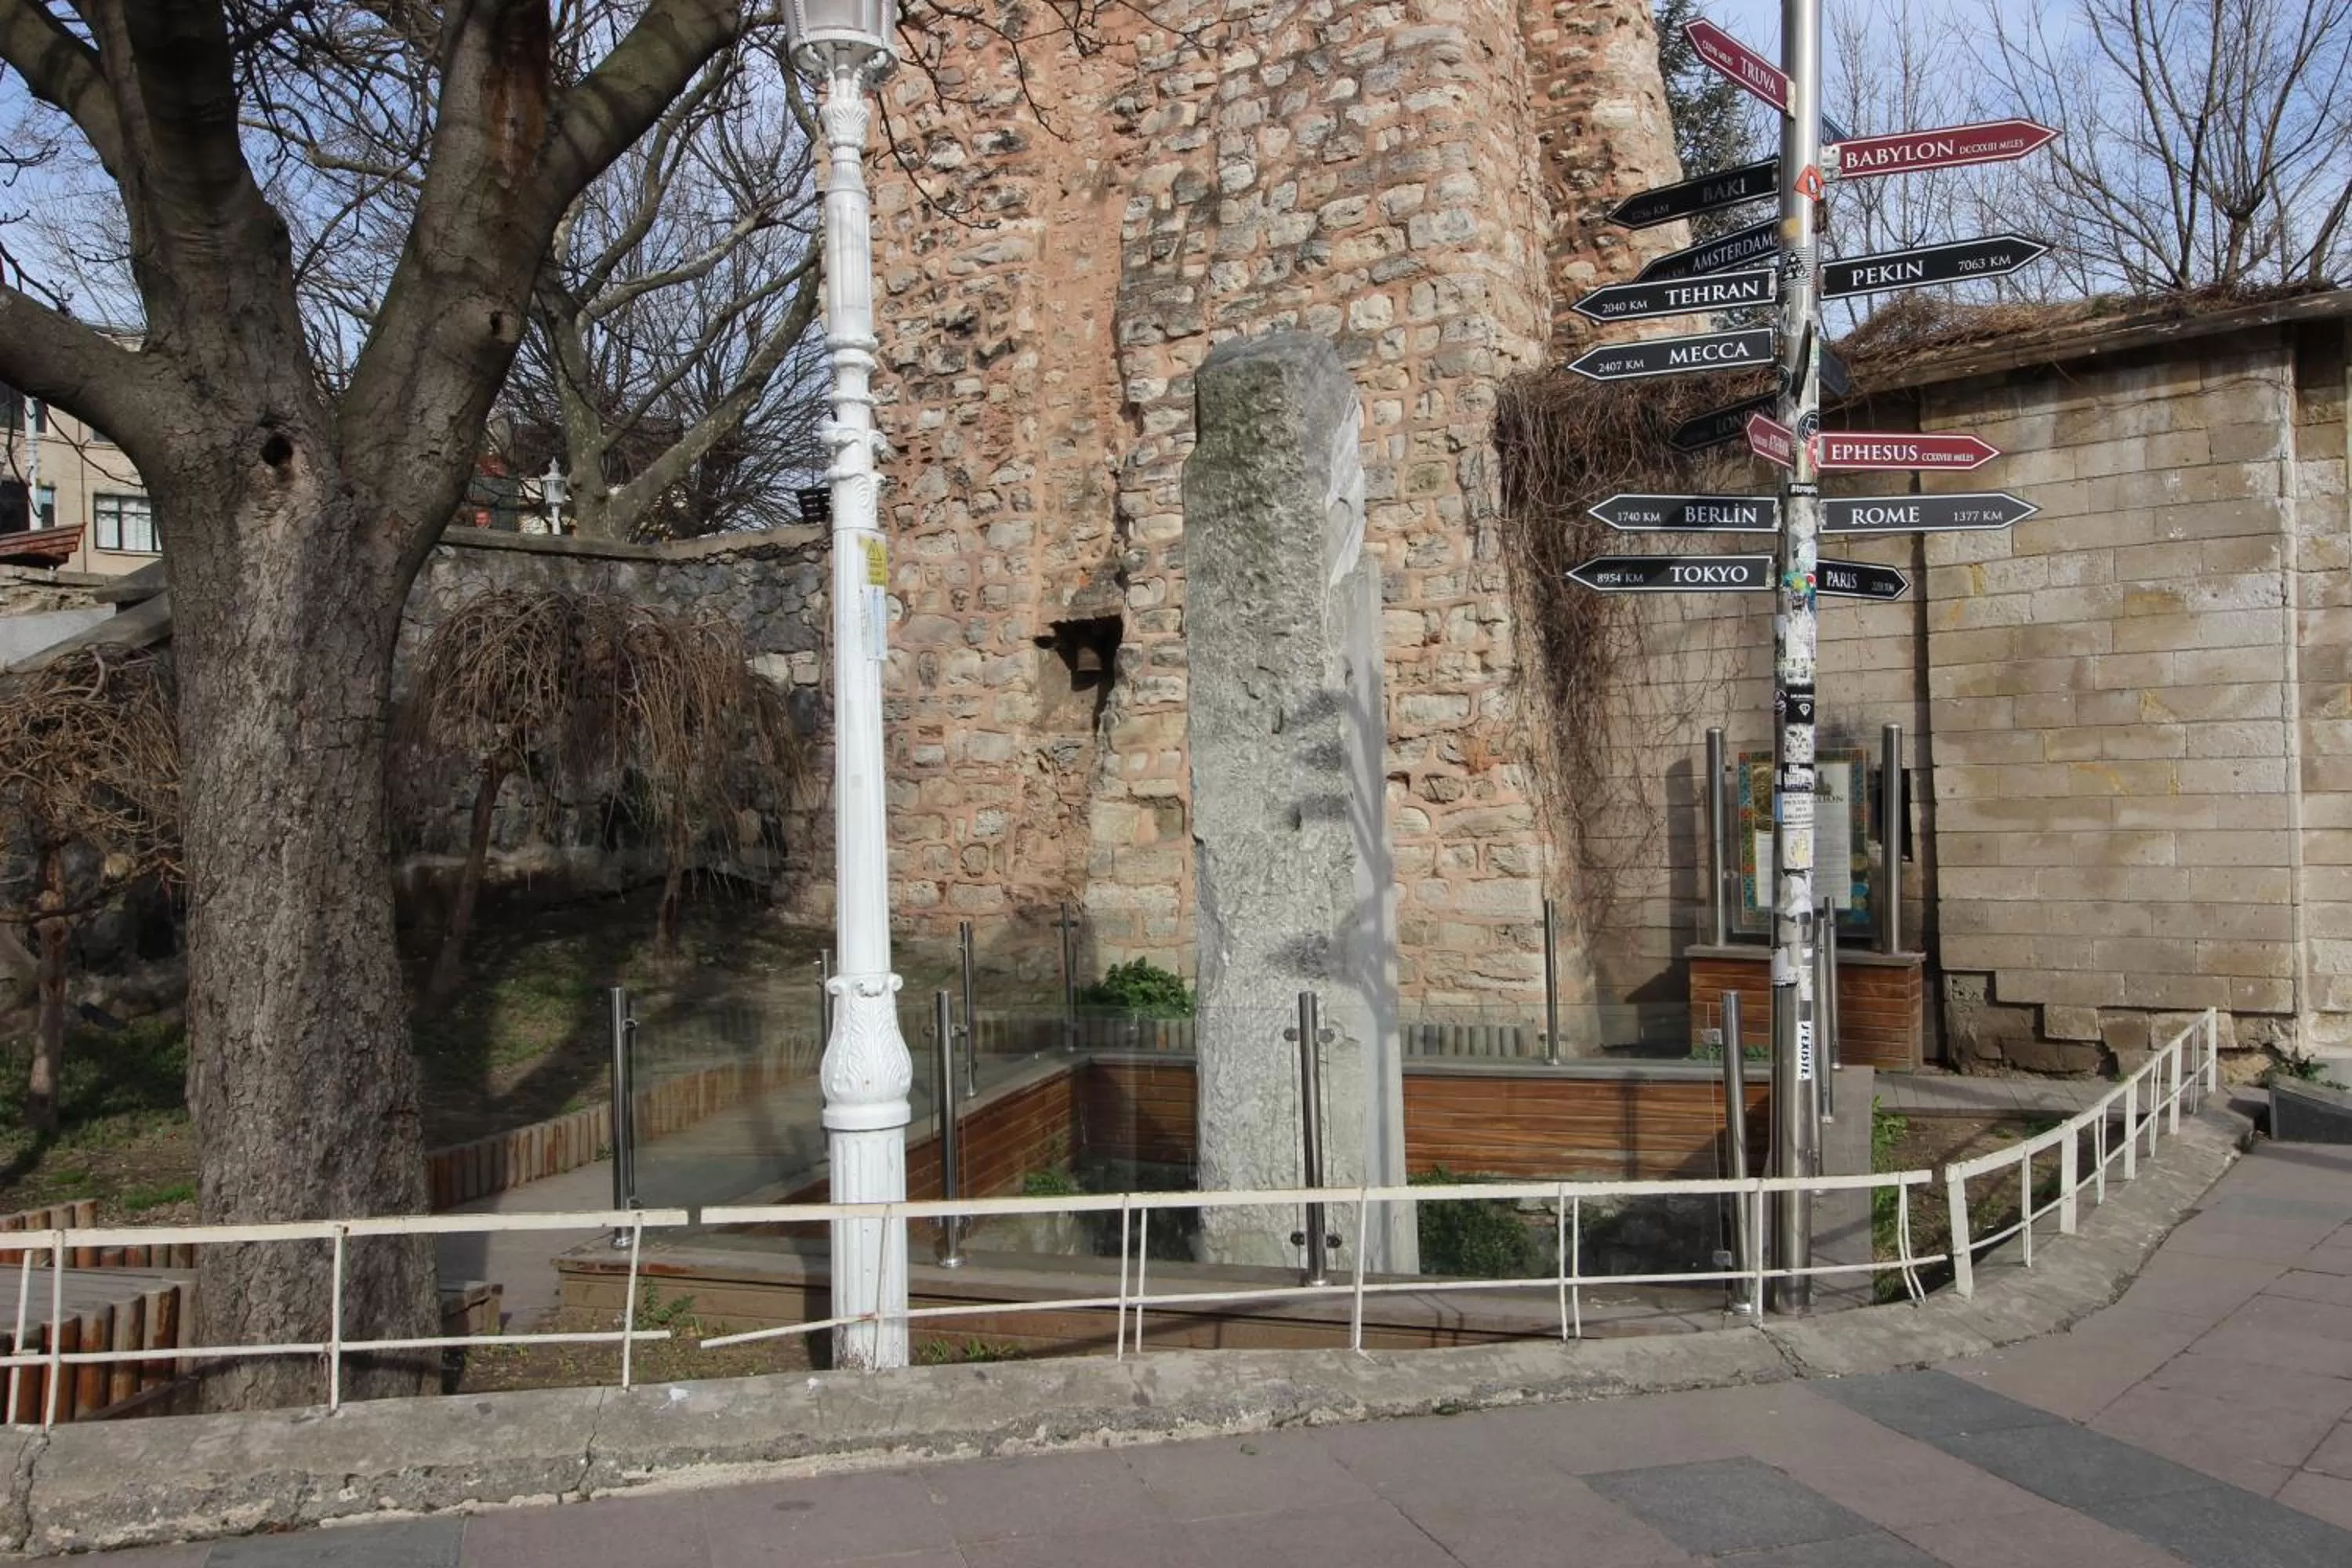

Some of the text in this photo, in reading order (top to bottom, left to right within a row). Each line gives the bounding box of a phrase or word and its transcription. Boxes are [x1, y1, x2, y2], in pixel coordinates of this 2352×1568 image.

[1740, 56, 1777, 95] TRUVA
[1845, 139, 1955, 169] BABYLON
[1998, 139, 2024, 149] MILES
[1702, 177, 1748, 203] BAKI
[1693, 232, 1774, 271] AMSTERDAM
[1851, 255, 2012, 287] PEKIN 7063 KM
[1602, 280, 1759, 314] 2040 KM TEHRAN
[1598, 341, 1750, 373] 2407 KM MECCA
[1831, 444, 1918, 462] EPHESUS
[1617, 503, 1758, 523] 1740 KM BERLİN
[1851, 506, 2003, 524] ROME 1377 KM
[1596, 565, 1748, 583] 8954 KM TOKYO
[1826, 570, 1857, 589] PARIS
